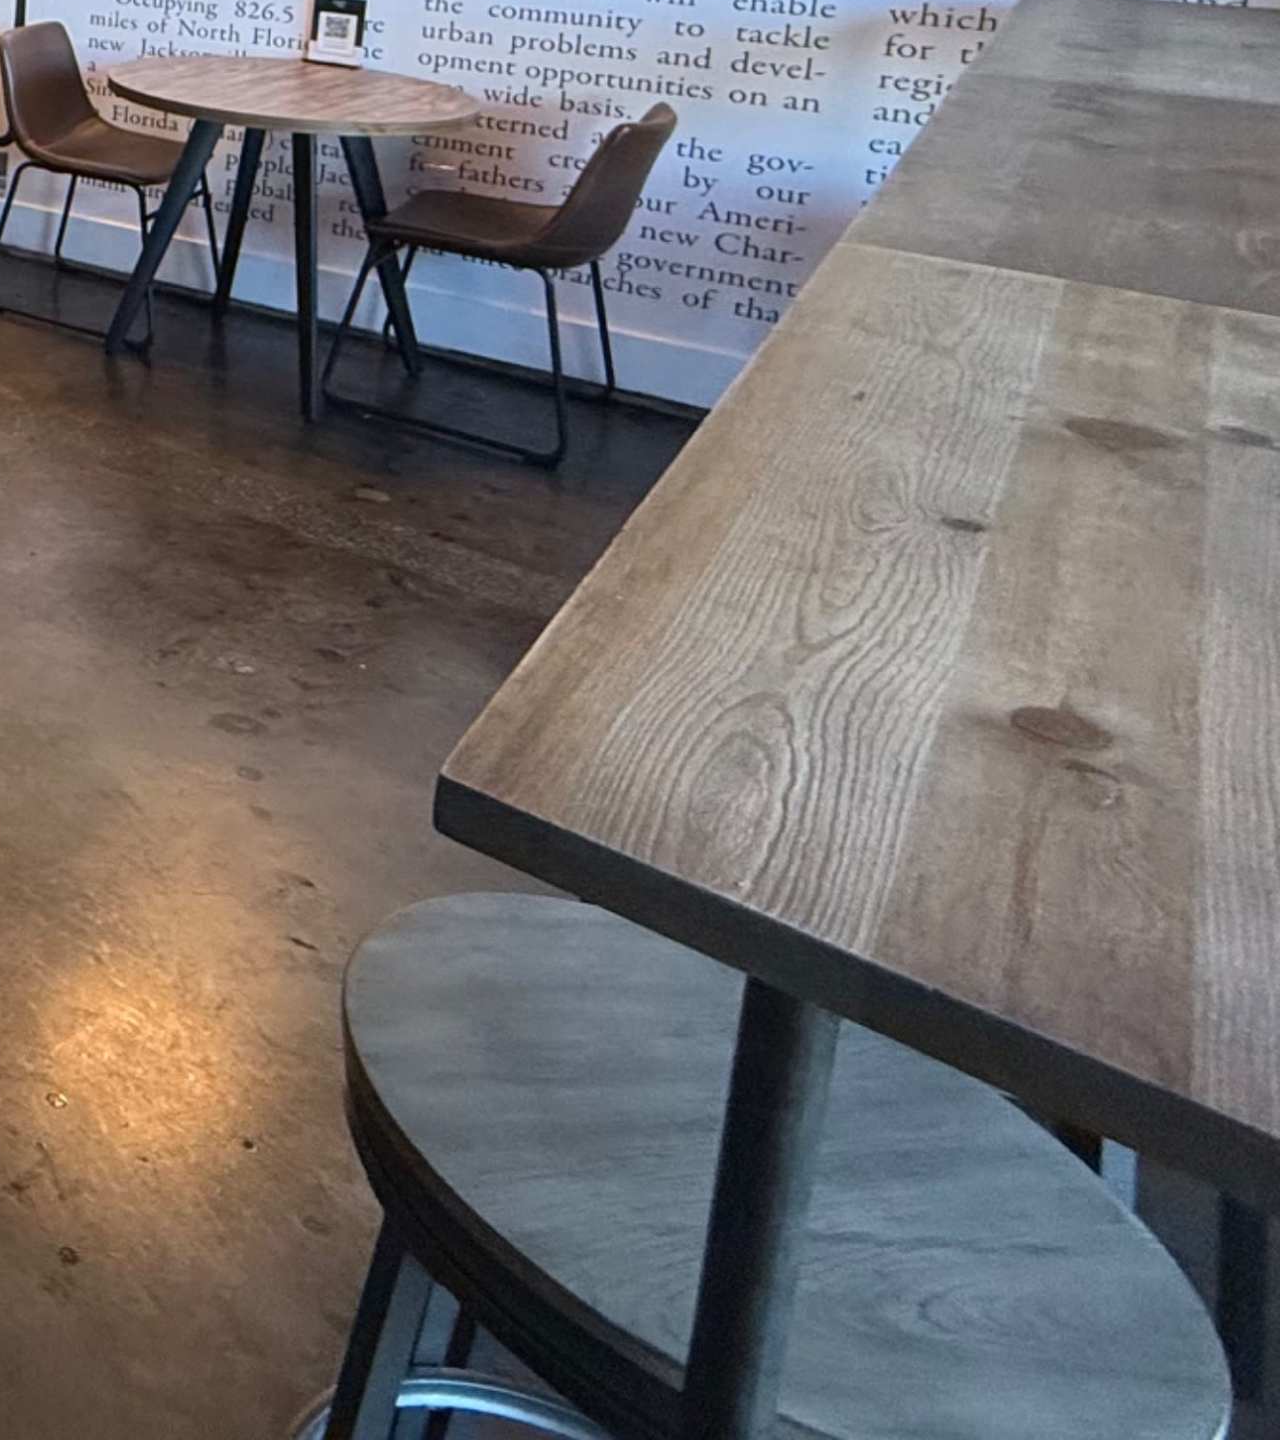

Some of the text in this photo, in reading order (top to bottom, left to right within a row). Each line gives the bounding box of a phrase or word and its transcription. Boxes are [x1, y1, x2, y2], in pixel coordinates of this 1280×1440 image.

[90, 11, 138, 31] miles
[178, 19, 240, 43] North
[234, 0, 294, 23] 826.5
[488, 3, 830, 50] community to tackle
[889, 2, 998, 32] which
[89, 36, 125, 52] new
[421, 20, 827, 80] urban problems devel-
[884, 33, 935, 60] for
[418, 52, 820, 113] opment opportunities on an
[111, 105, 178, 131] Florida
[484, 85, 632, 119] wide basis.
[746, 154, 814, 175] gov-
[683, 165, 810, 205] by our
[697, 201, 807, 235] Ameri-
[640, 226, 805, 265] new Char-
[616, 248, 803, 300] government
[682, 289, 718, 310] of
